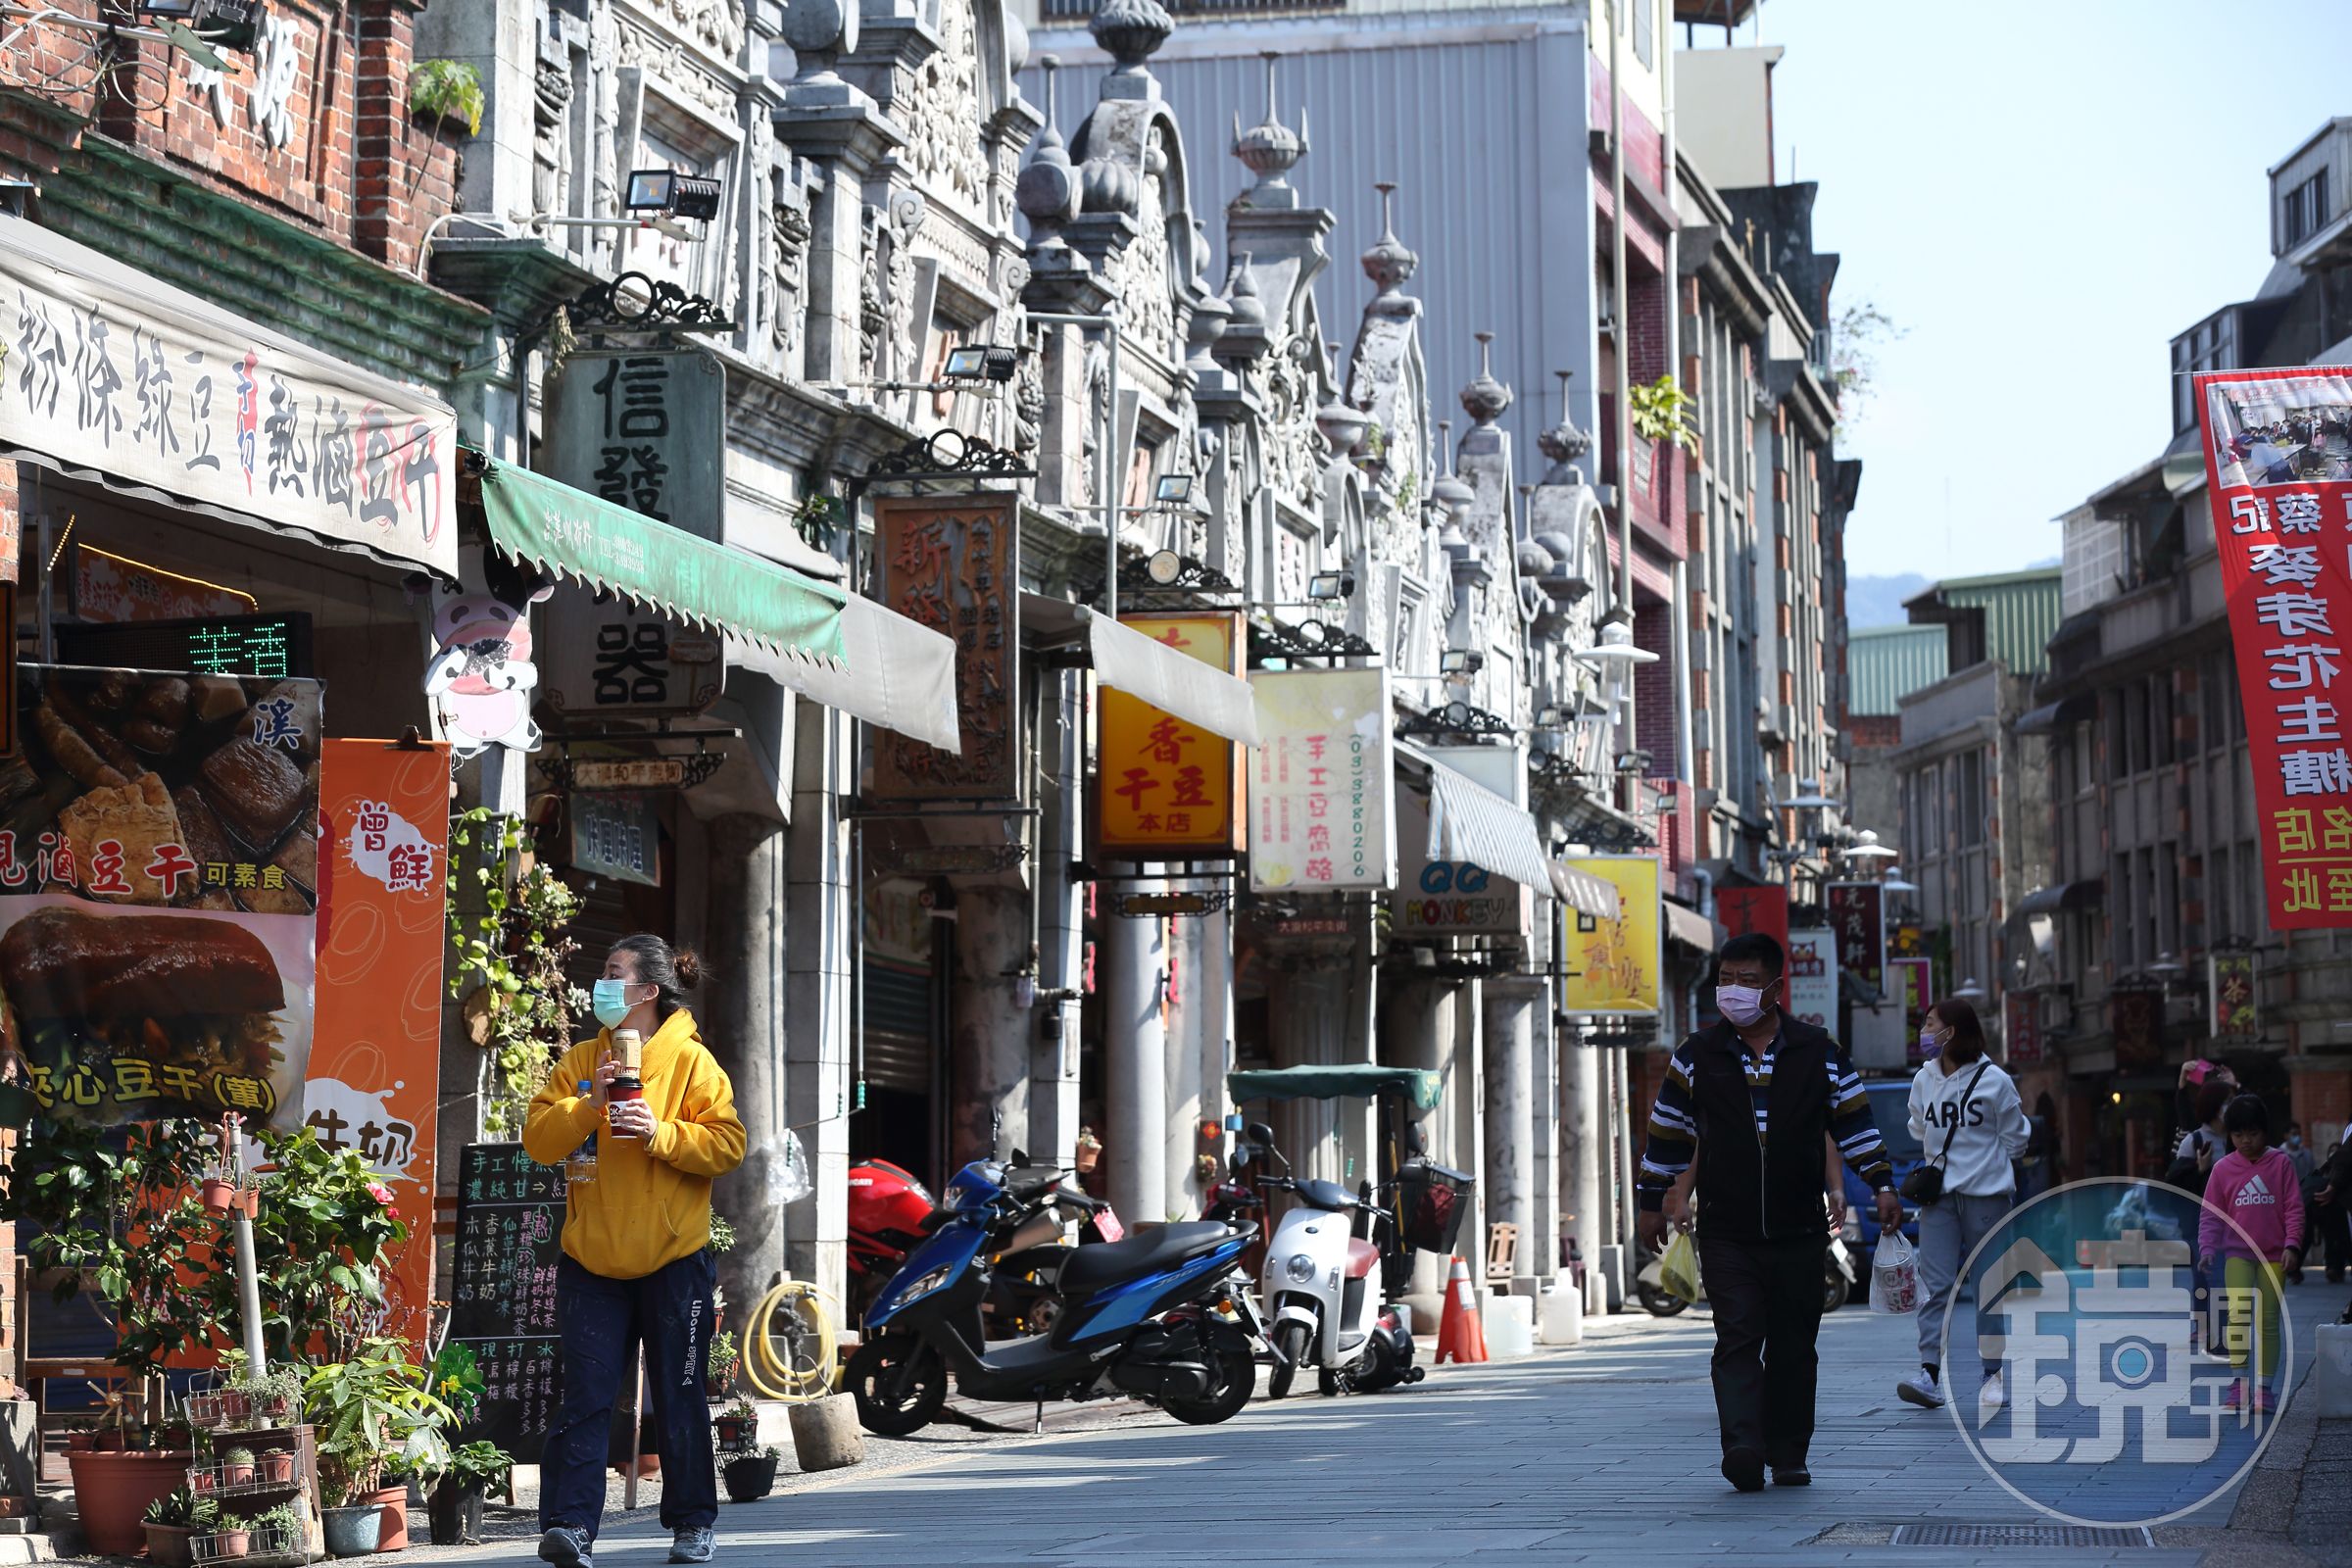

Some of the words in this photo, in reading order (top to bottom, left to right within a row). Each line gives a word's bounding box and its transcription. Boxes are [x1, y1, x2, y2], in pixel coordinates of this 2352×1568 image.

[1137, 813, 1191, 833] 本店
[206, 861, 286, 890] 可素食
[1406, 898, 1505, 925] MONKEY
[2234, 1193, 2276, 1206] adidas
